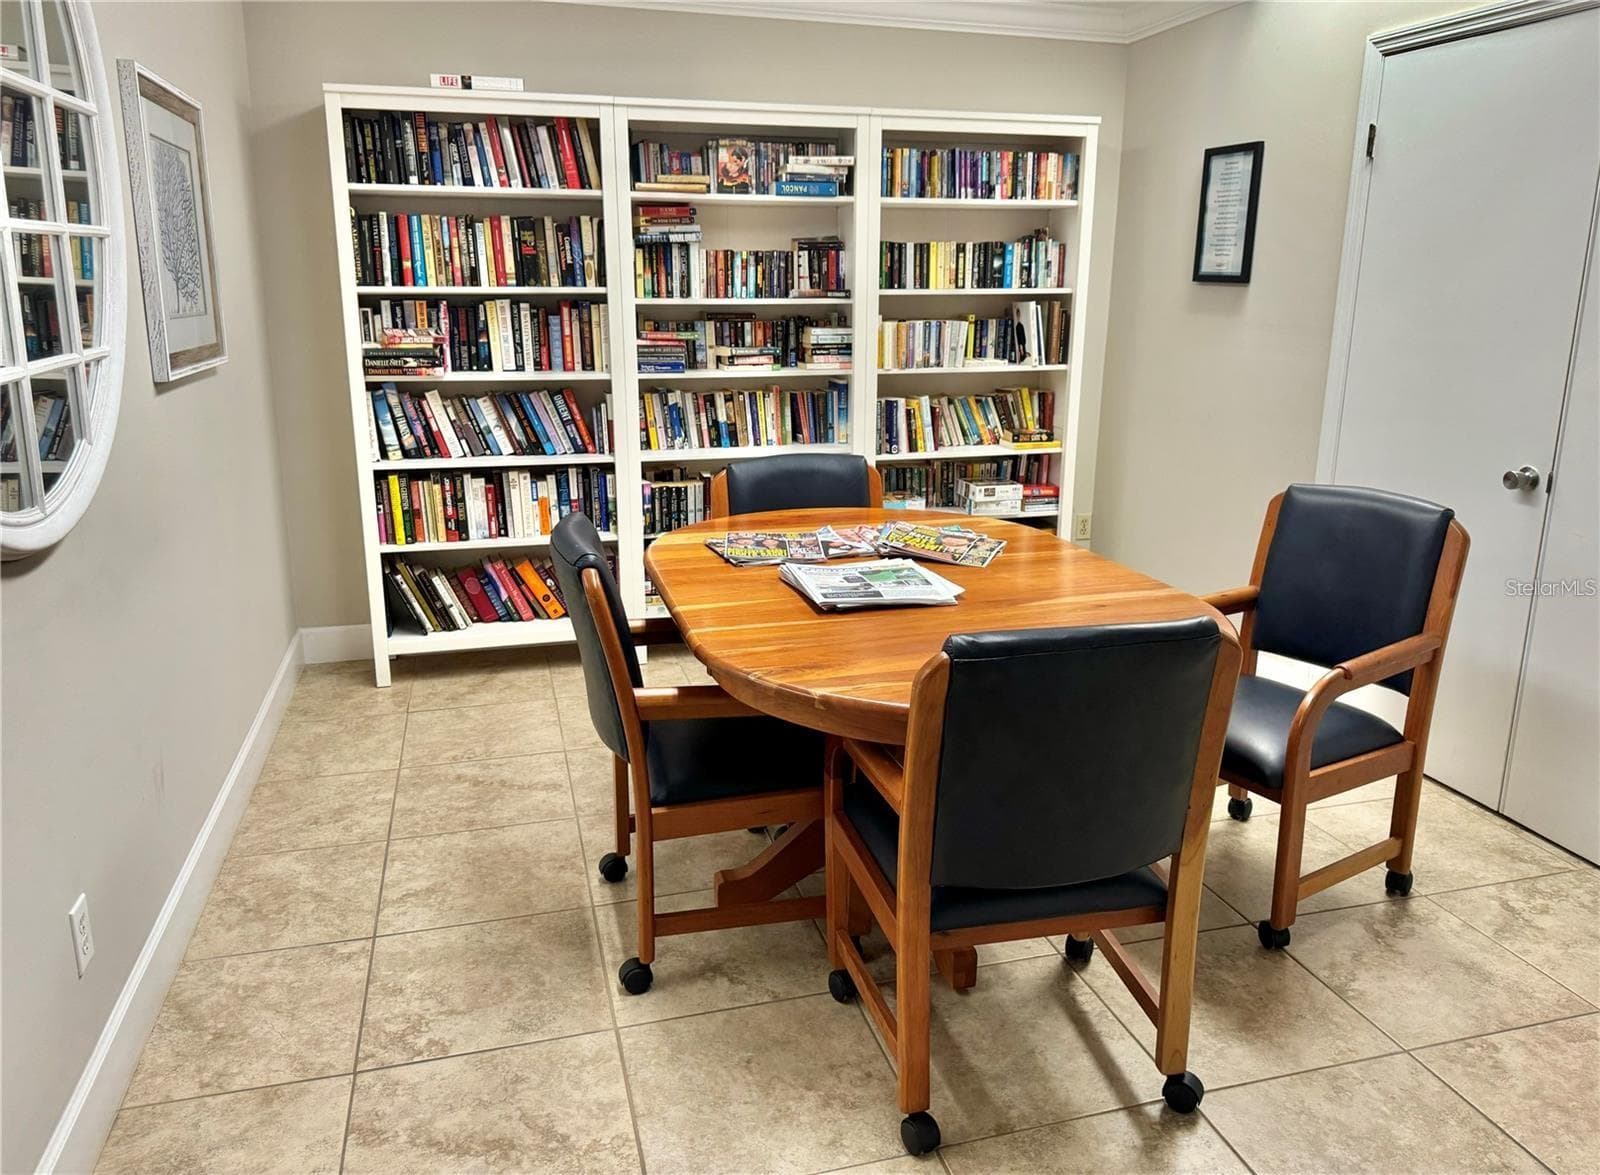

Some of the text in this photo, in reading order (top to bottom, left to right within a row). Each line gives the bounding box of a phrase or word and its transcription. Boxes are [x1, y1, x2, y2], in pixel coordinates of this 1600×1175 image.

[439, 76, 458, 87] LIFE
[781, 184, 808, 193] PANCOL
[365, 358, 390, 367] DANIELLE
[368, 367, 390, 375] DANIELLE
[553, 394, 571, 422] ORIENT
